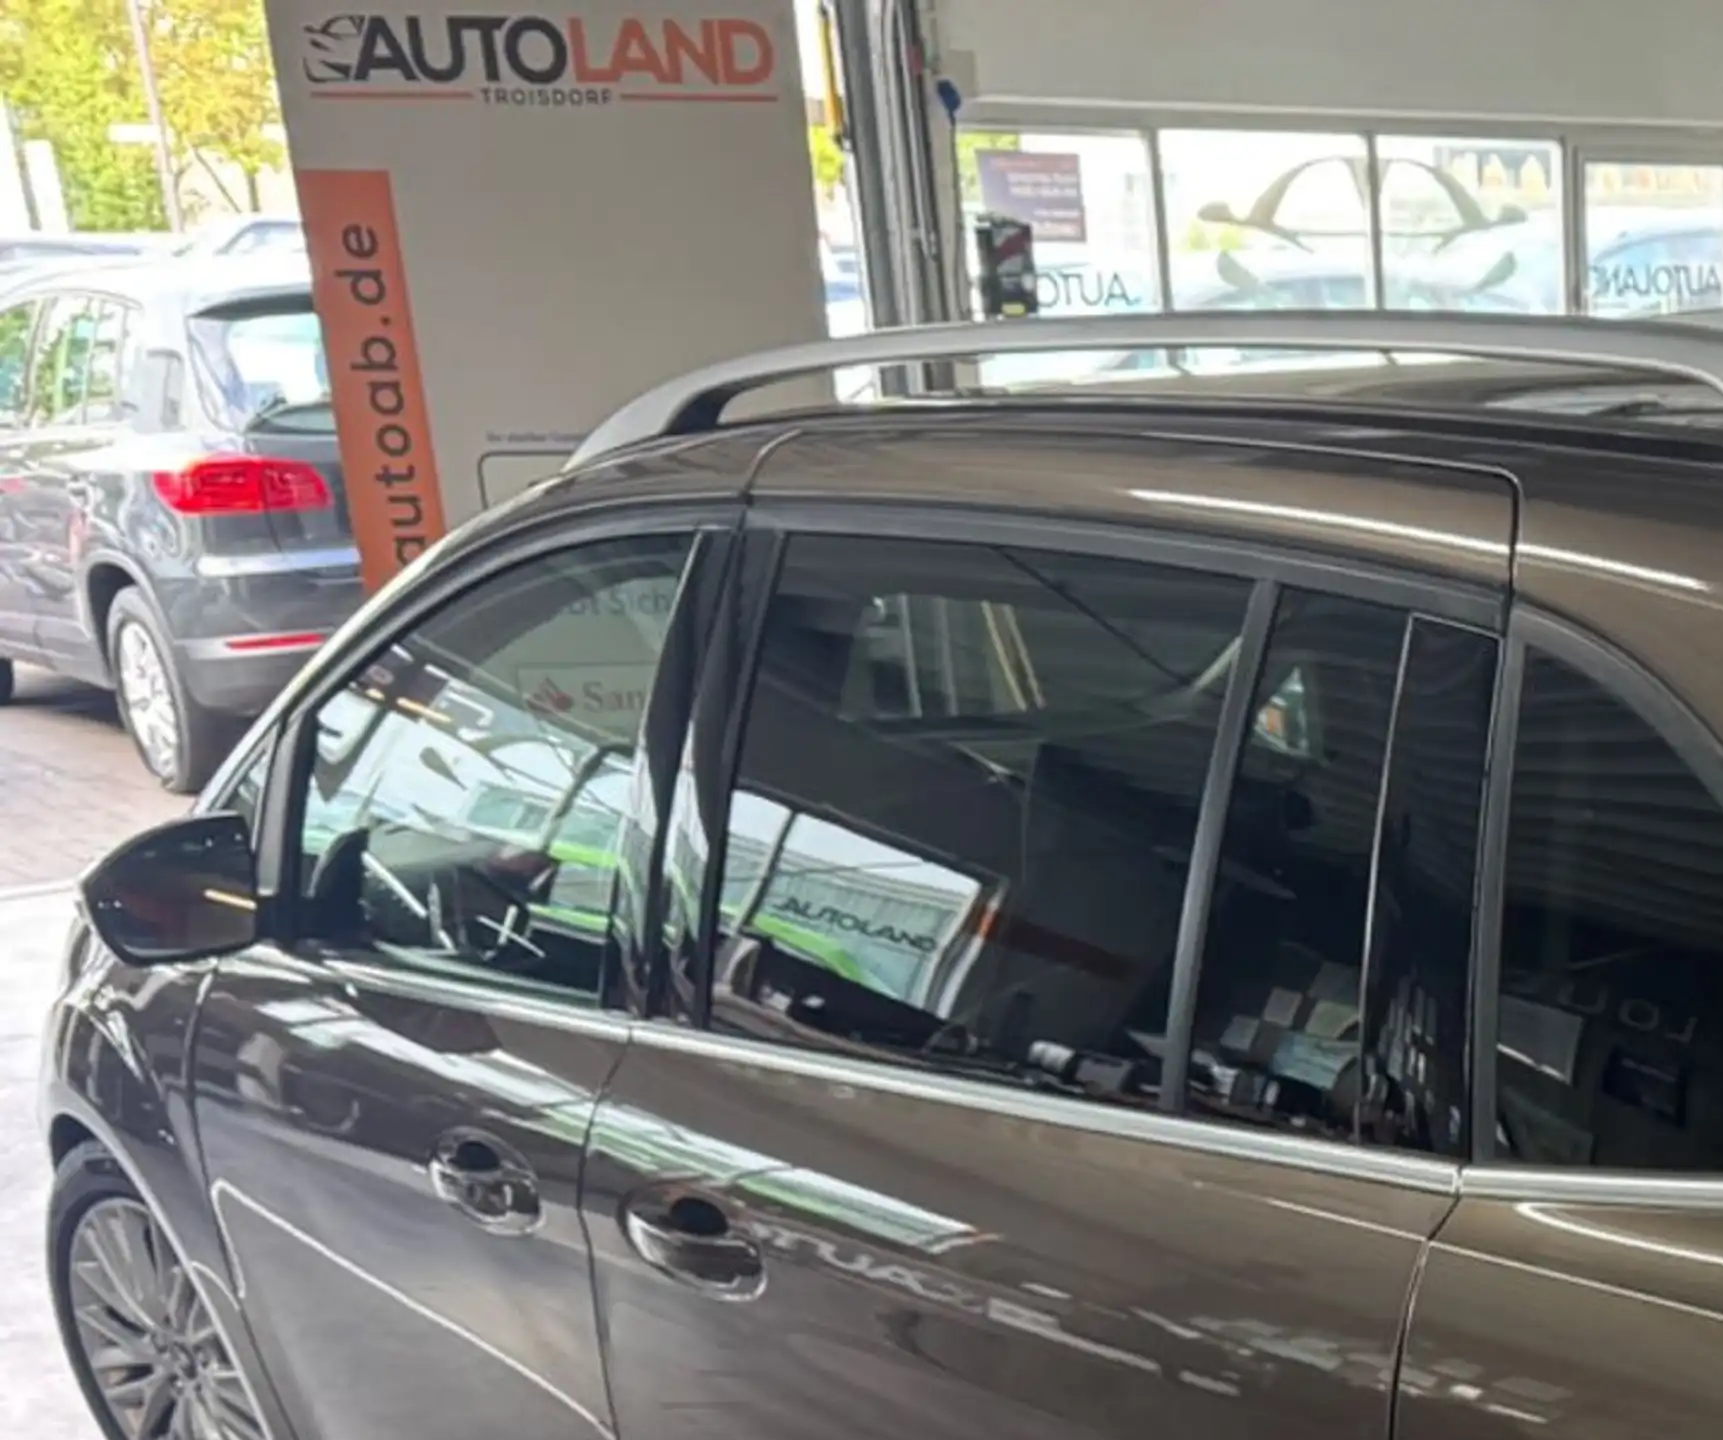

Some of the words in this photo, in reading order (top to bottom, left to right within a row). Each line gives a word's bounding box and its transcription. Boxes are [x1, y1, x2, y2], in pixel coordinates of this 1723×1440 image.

[353, 15, 775, 85] AUTOLAND
[481, 87, 613, 105] TROISDORF
[772, 897, 937, 953] AUTOLAND
